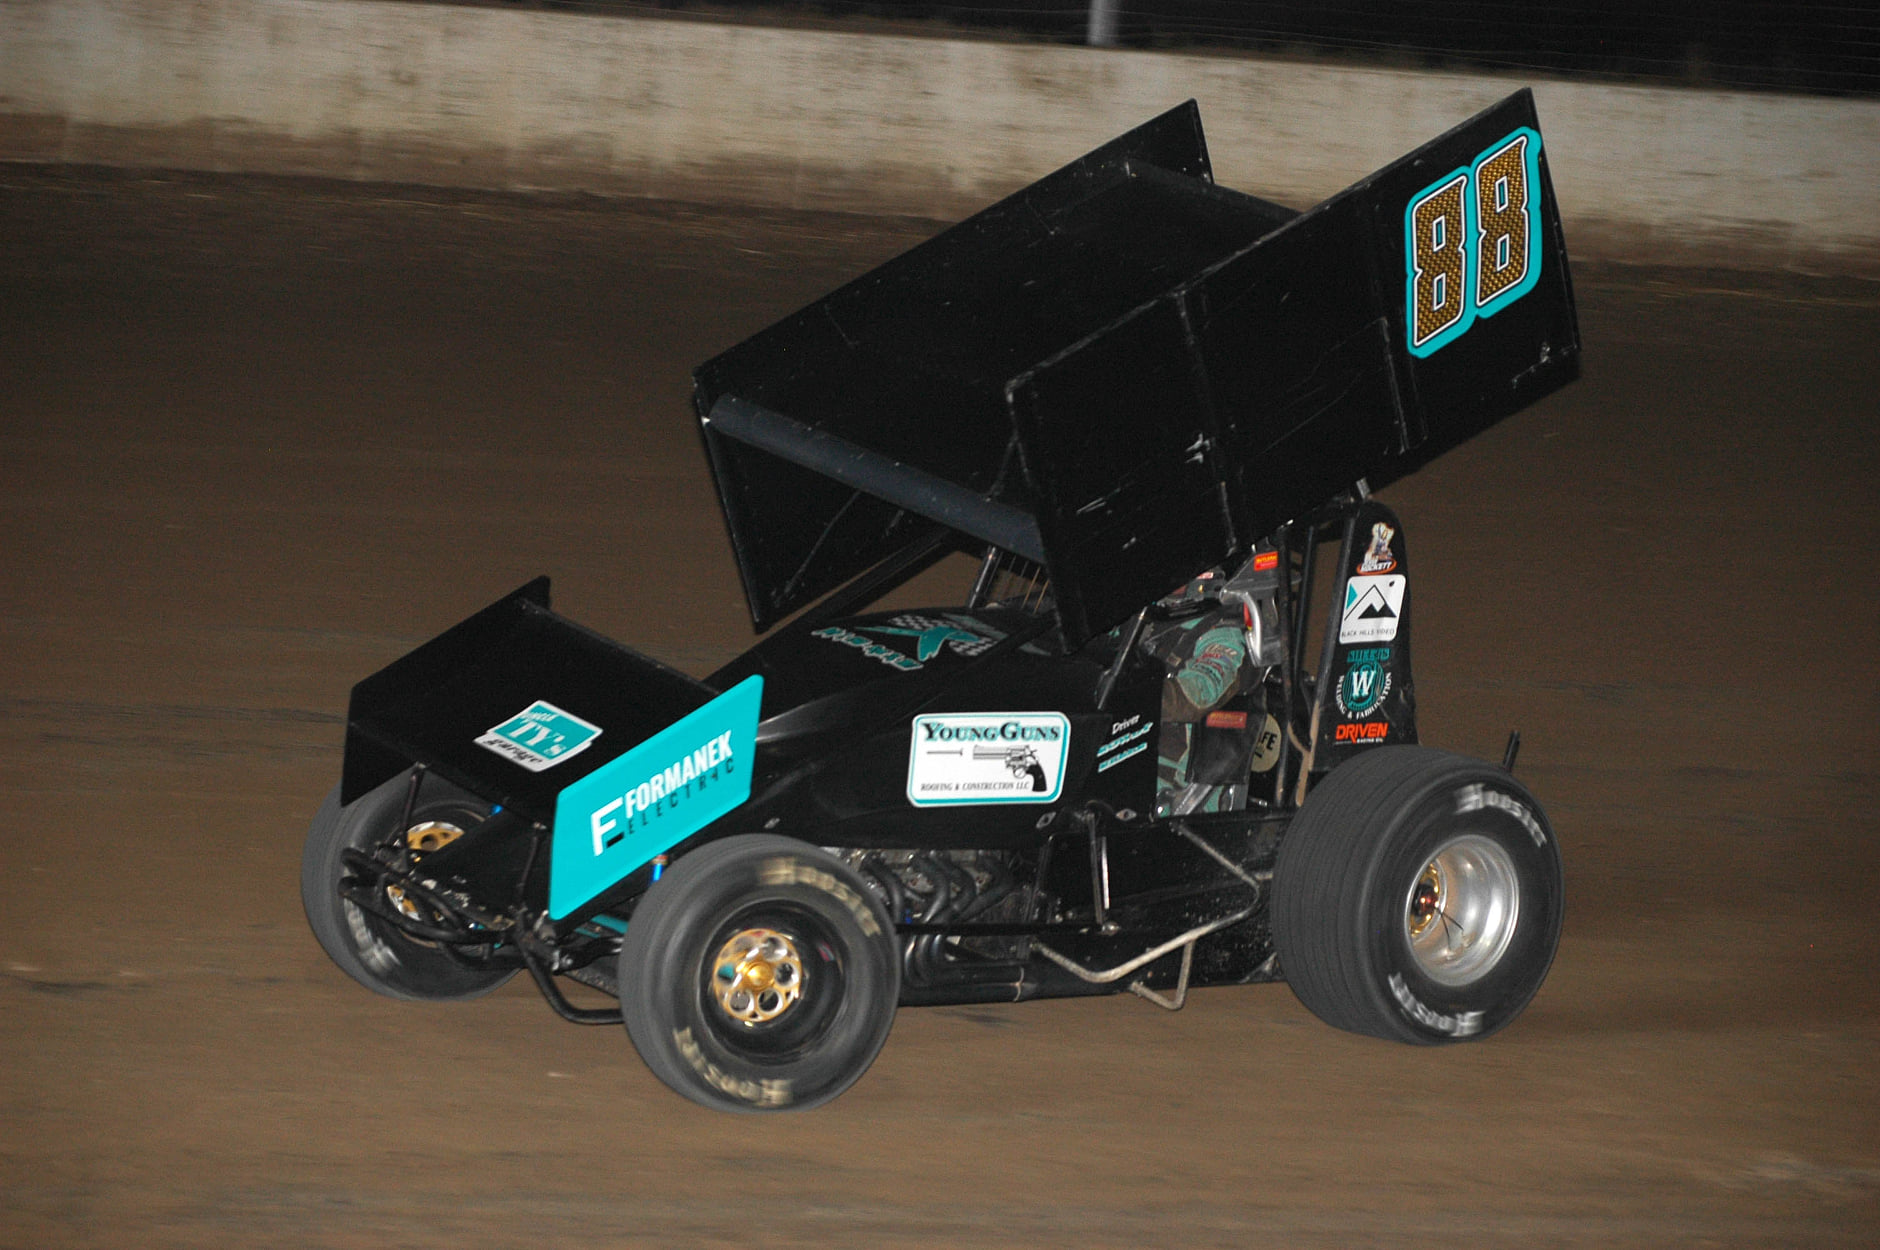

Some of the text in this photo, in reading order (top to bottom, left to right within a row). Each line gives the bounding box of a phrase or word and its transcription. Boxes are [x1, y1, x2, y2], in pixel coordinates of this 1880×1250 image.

[1408, 130, 1538, 354] 88
[1112, 714, 1141, 735] Driver
[1335, 722, 1389, 744] DRIVEN
[625, 730, 733, 819] FORMANEK
[920, 782, 953, 792] ROOFING
[962, 781, 1014, 791] CONSTRUCTION
